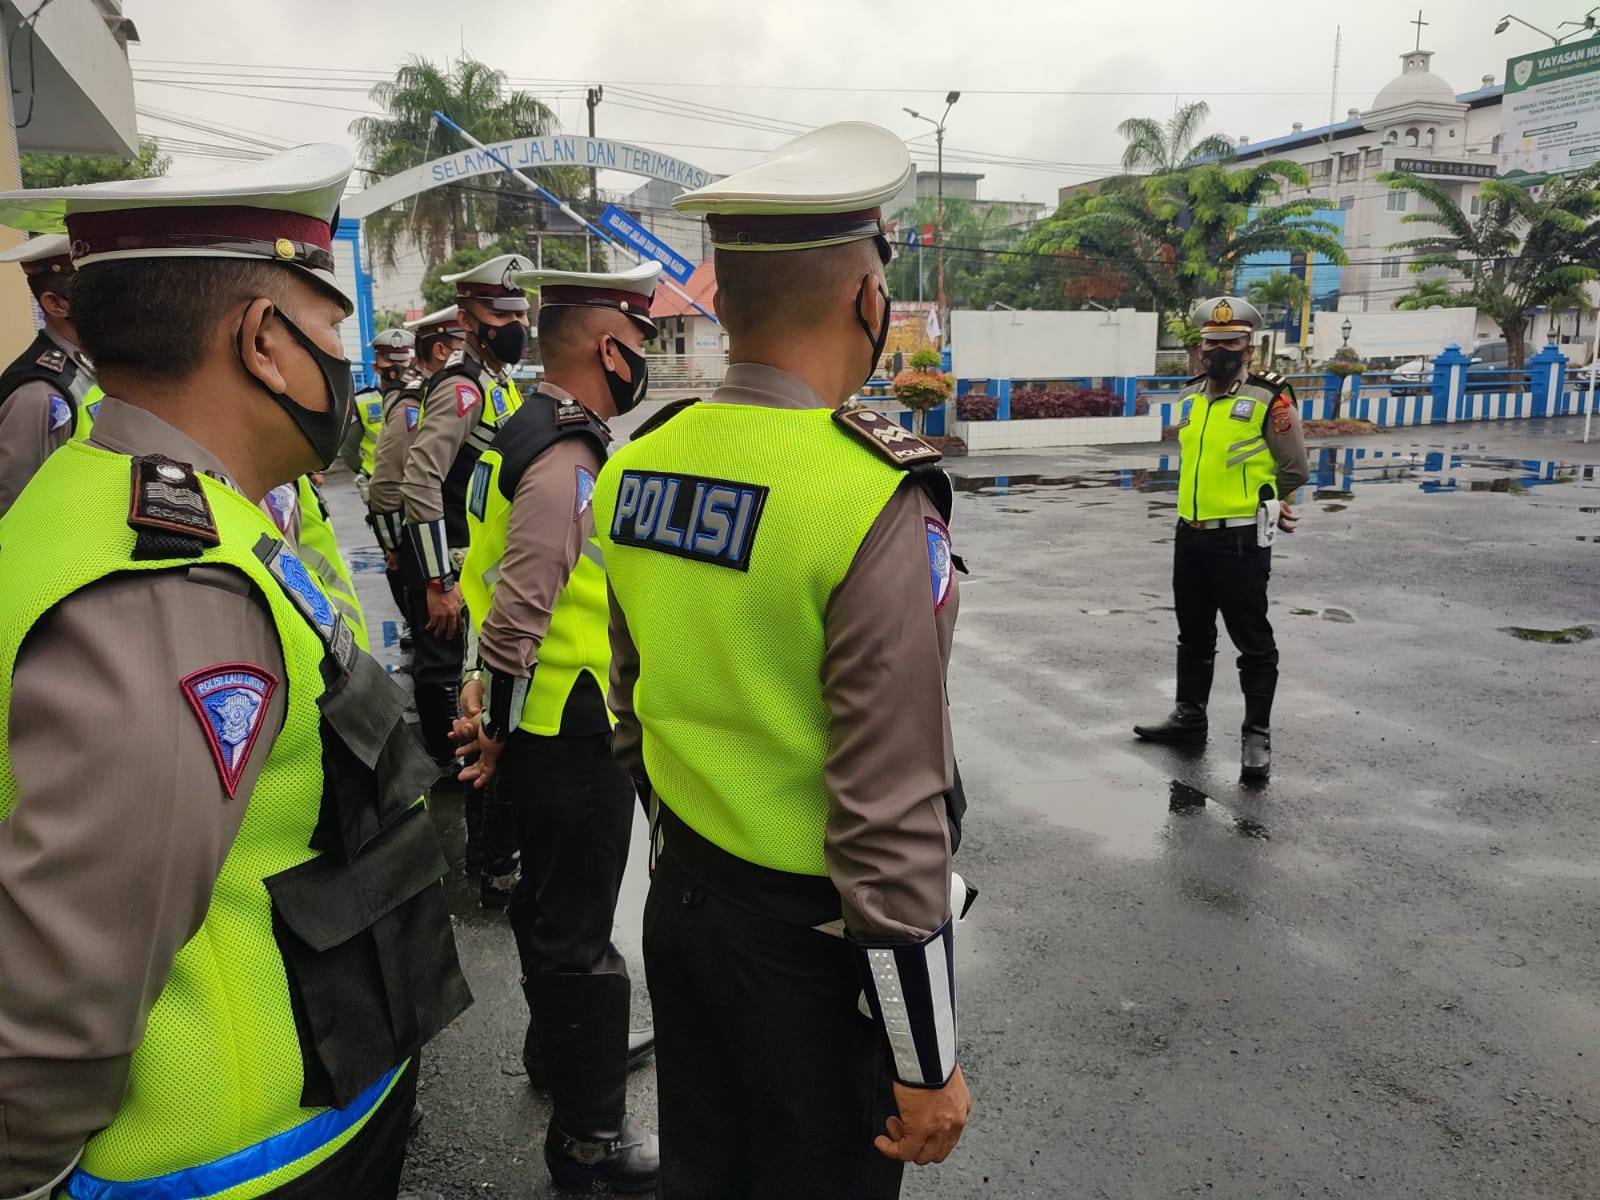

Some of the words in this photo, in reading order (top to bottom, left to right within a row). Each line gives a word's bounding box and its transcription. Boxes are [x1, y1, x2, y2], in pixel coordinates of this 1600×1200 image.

[1537, 48, 1586, 70] YAYASAN
[432, 145, 513, 181] SELAMAT
[518, 139, 576, 163] JALAN
[586, 141, 616, 167] DAN
[894, 446, 934, 458] POLISI
[146, 504, 210, 528] POLISI
[612, 474, 757, 562] POLISI
[196, 675, 226, 695] POLISI
[225, 673, 242, 685] LALU
